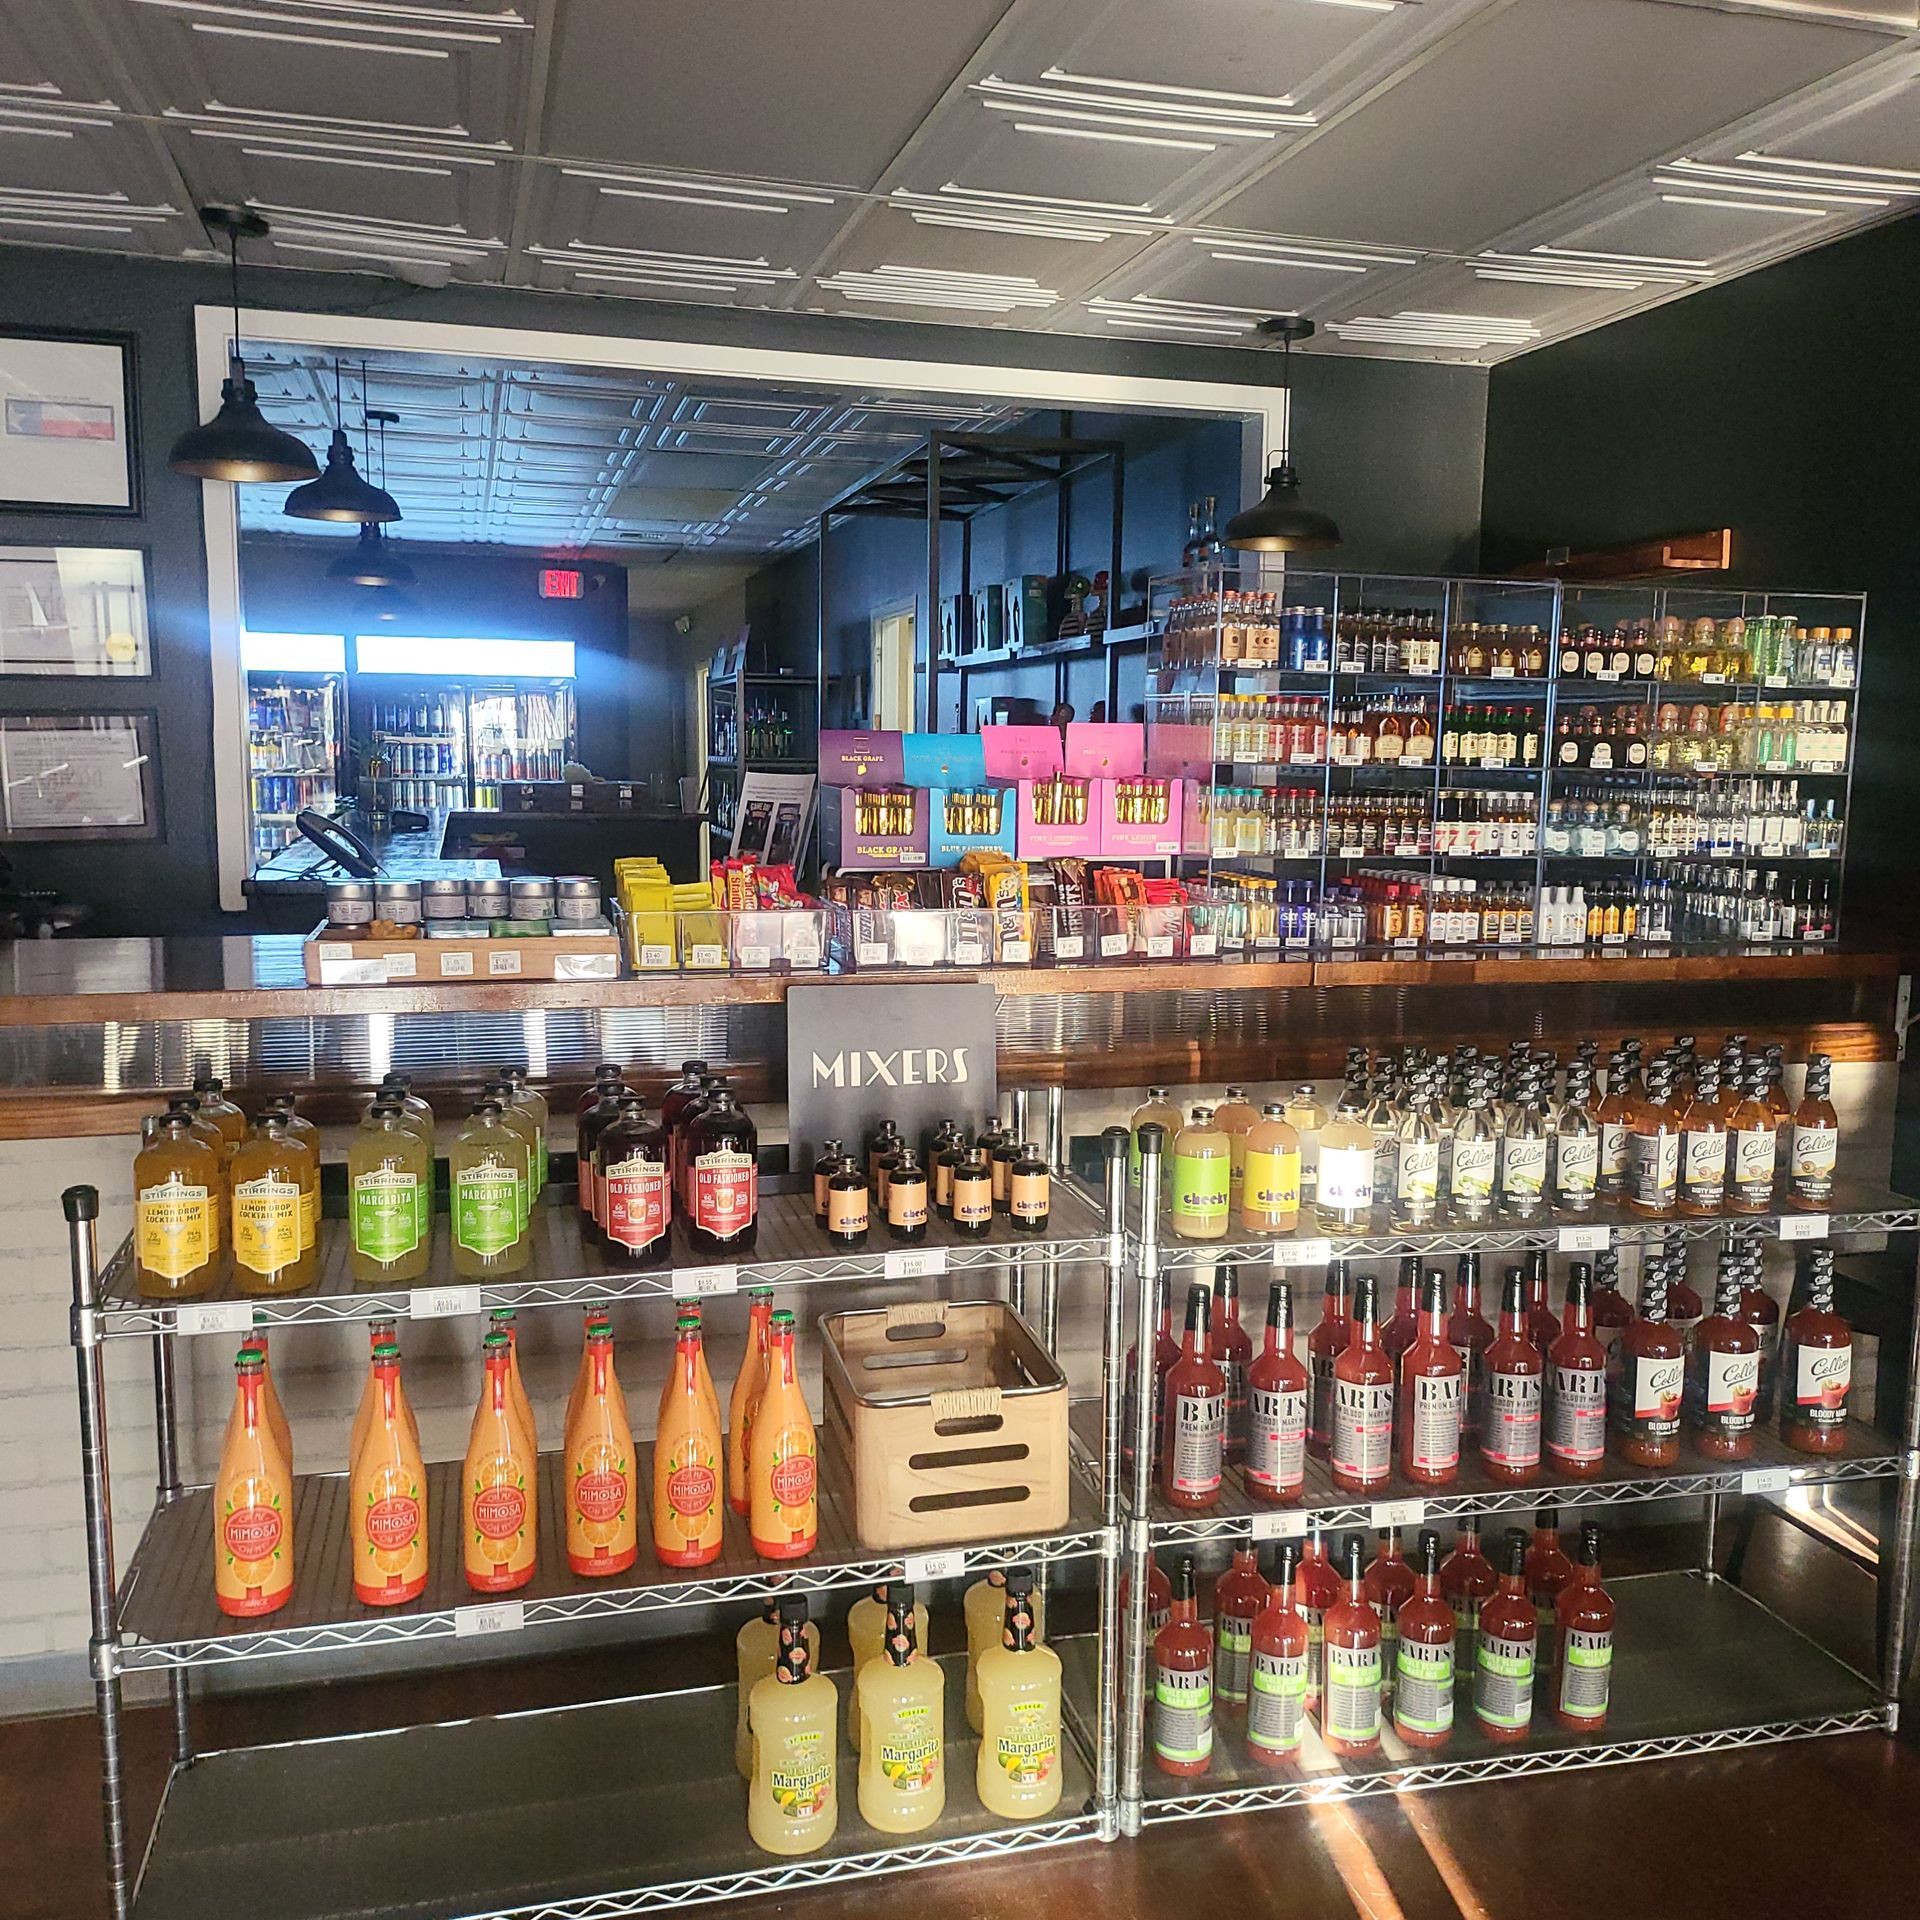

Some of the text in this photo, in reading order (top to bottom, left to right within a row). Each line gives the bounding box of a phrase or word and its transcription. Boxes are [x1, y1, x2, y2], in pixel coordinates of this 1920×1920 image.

[545, 570, 578, 597] EXIT
[857, 846, 914, 854] BLACK GRAPE
[812, 1048, 969, 1089] MIXERS
[700, 1157, 749, 1165] STIRRINGS
[461, 1172, 514, 1180] STIRRINGS
[610, 1166, 661, 1175] STIRRINGS
[359, 1177, 412, 1185] STIRRINGS
[700, 1173, 749, 1184] OLD FASHIONED
[238, 1187, 295, 1195] STIRRINGS
[610, 1182, 661, 1193] OLD FASHIONED
[1329, 1186, 1371, 1198] cheky
[360, 1194, 411, 1205] MARGARITA
[462, 1189, 512, 1199] MARGARITA
[1183, 1192, 1227, 1205] cheeky
[177, 1206, 200, 1214] DROP
[146, 1213, 201, 1223] COCKTAIL MIX
[1557, 1372, 1600, 1394] ART
[1339, 1385, 1392, 1409] ARTS
[1253, 1393, 1306, 1416] ARTS
[1810, 1408, 1834, 1417] BLOODY
[1721, 1416, 1745, 1424] BLOODY
[1648, 1422, 1672, 1430] BLOODY
[777, 1472, 812, 1489] MIMOSA
[580, 1488, 621, 1500] MIMOSA
[673, 1485, 711, 1496] MIMOSA
[479, 1503, 521, 1518] MIMOSA
[371, 1515, 415, 1530] MIMOSA
[230, 1524, 276, 1539] MIMOSA
[924, 1562, 946, 1571] $15.05
[882, 1739, 939, 1763] Margarita
[999, 1736, 1056, 1757] Margarita
[1022, 1756, 1039, 1764] MIX
[906, 1763, 922, 1772] MIX
[773, 1763, 831, 1791] Margarita
[797, 1791, 814, 1800] MIX
